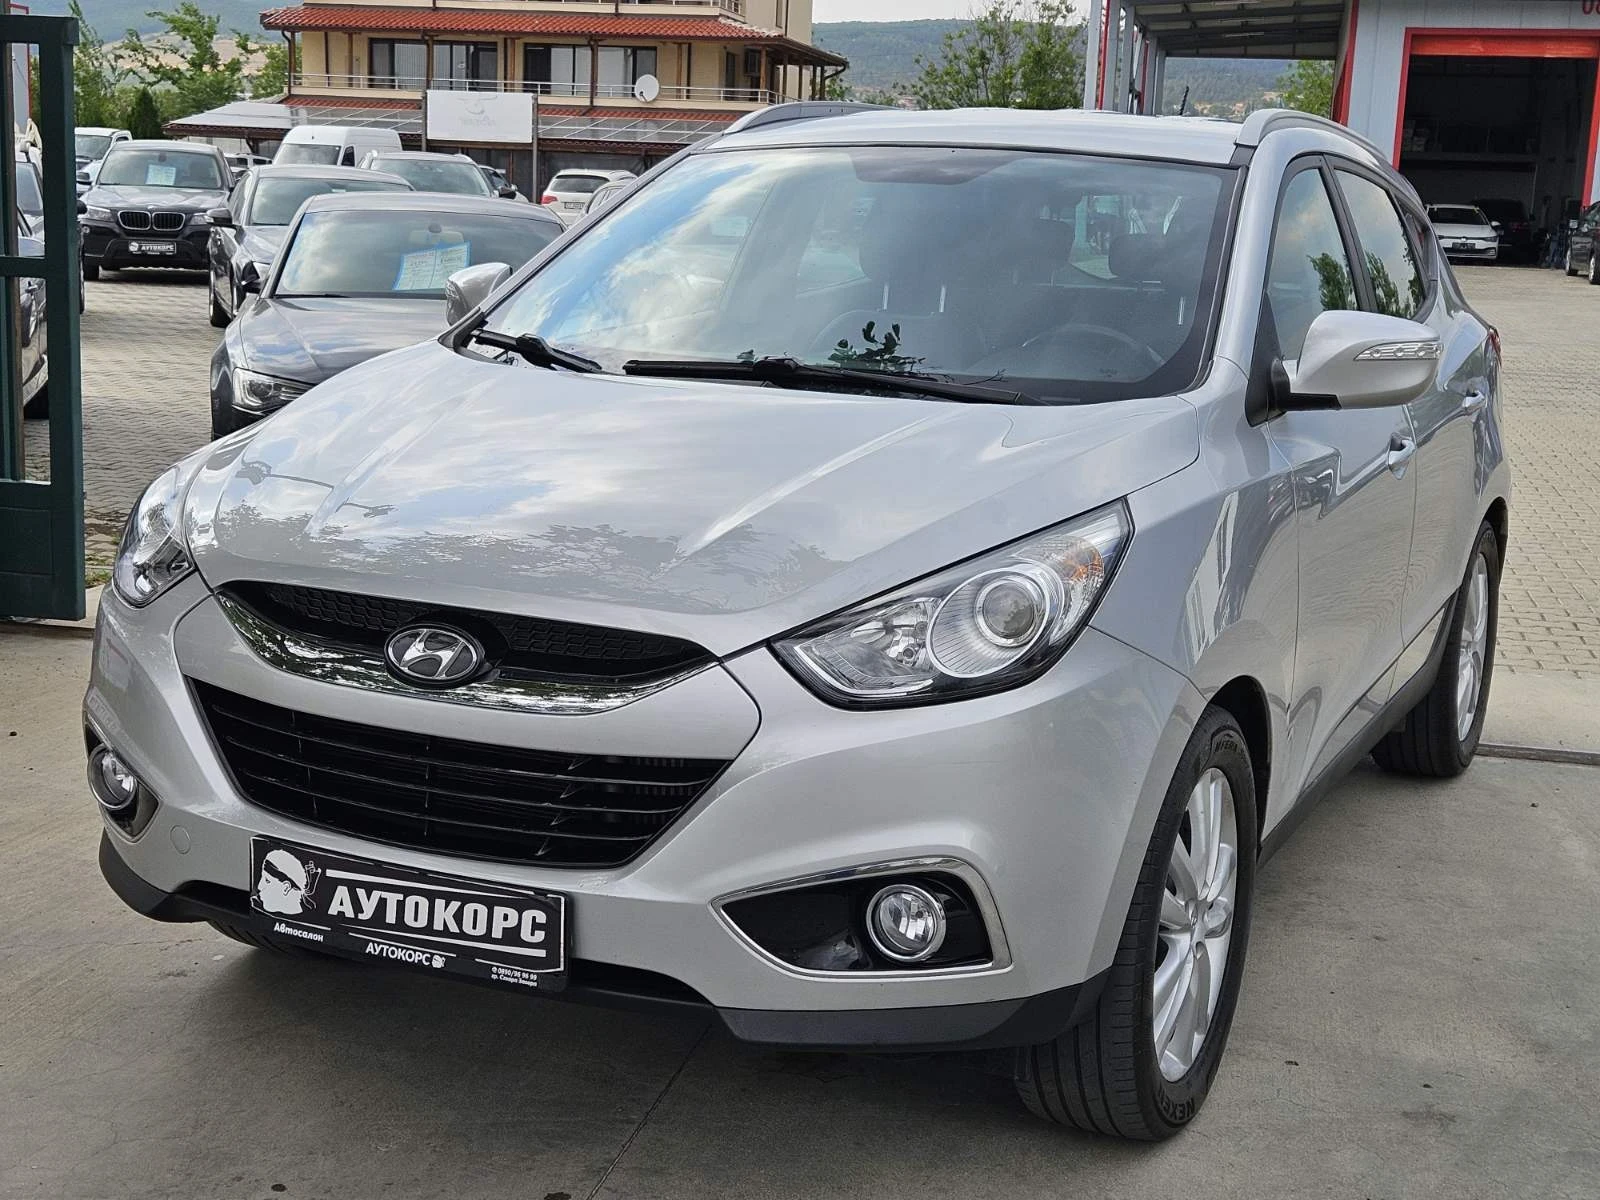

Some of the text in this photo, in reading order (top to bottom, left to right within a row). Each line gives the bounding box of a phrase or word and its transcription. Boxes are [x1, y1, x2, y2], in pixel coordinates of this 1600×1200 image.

[328, 885, 547, 943] АУТОКОРС
[273, 922, 324, 942] Автосалон
[365, 942, 431, 966] АУТОКОРС
